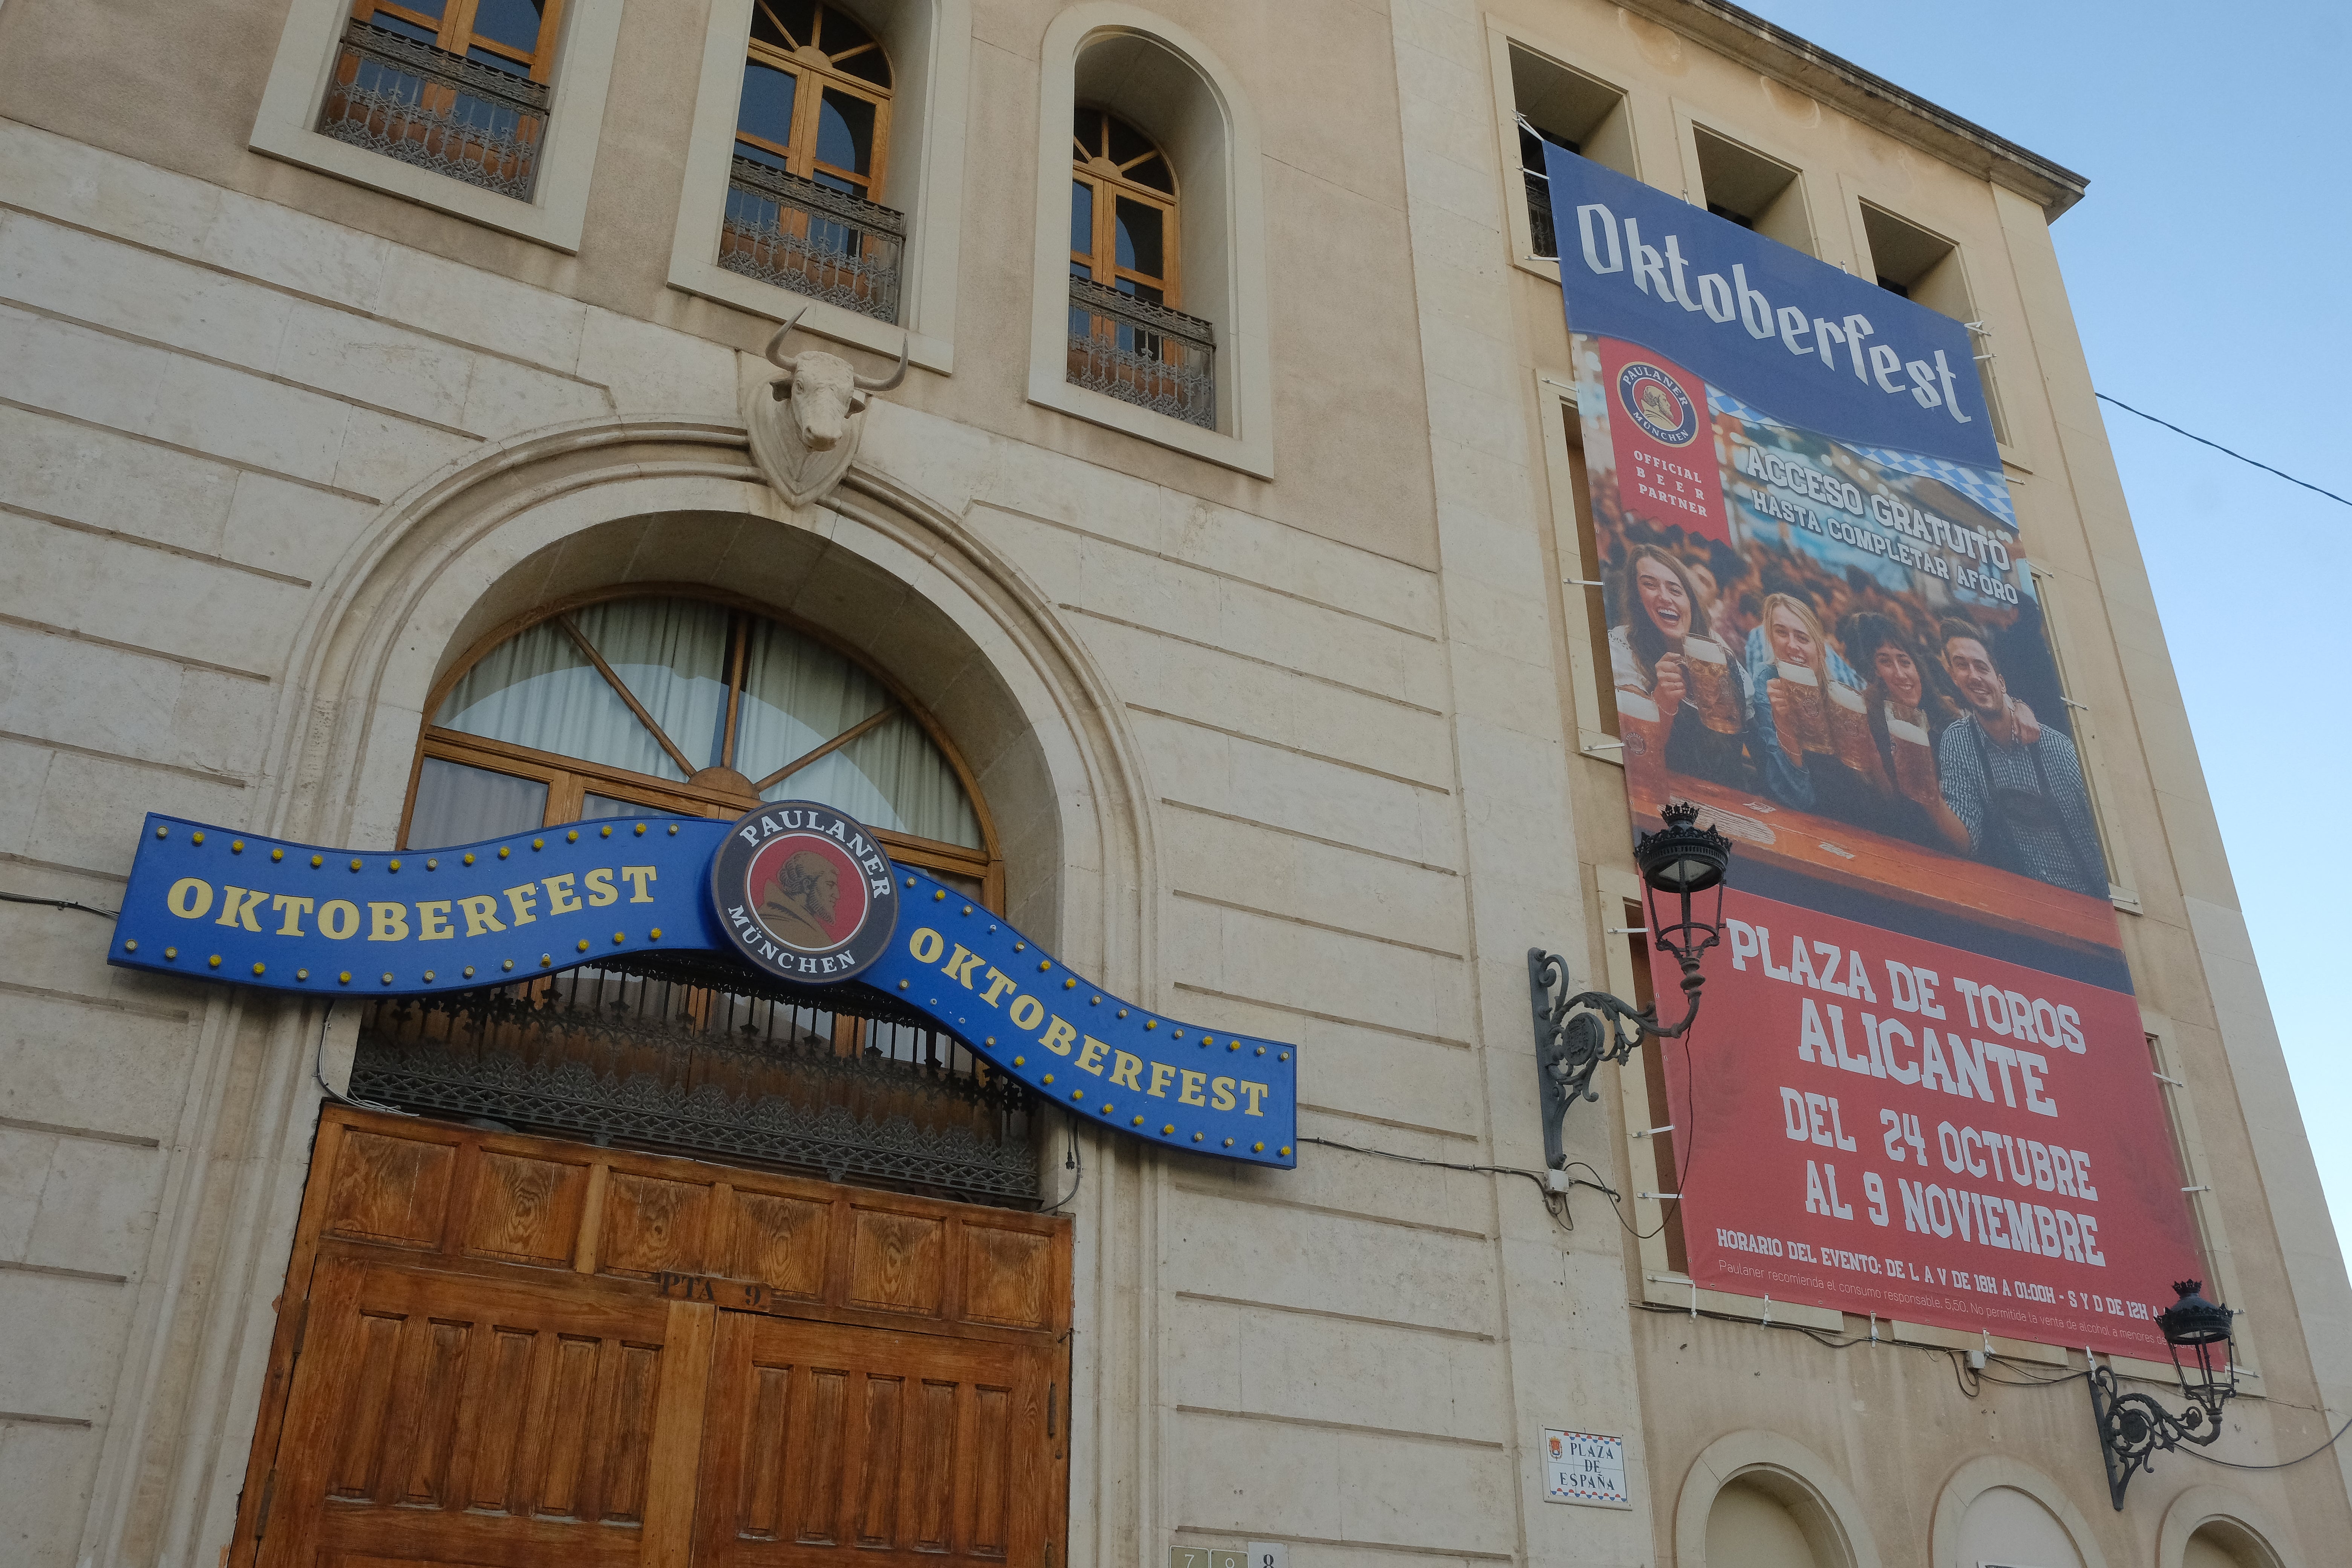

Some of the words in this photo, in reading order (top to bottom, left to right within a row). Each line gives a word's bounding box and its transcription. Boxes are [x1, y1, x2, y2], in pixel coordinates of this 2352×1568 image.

[1577, 204, 1971, 424] Oktoberfest
[1623, 367, 1688, 406] PAULANER
[1633, 412, 1689, 441] MÜNCHEN
[1634, 450, 1701, 483] OFFICIAL
[1638, 483, 1707, 517] PARTNER
[1747, 447, 1864, 515] ACCESO
[1871, 494, 2010, 570] GRATUITO
[1752, 489, 1821, 533] HASTA
[1828, 518, 1949, 579] COMPLETAR
[1957, 566, 2018, 604] AFORO
[739, 810, 890, 899] PAULANER
[167, 865, 657, 941] OKTOBERFEST
[728, 905, 855, 974] MÜNCHEN
[909, 927, 1269, 1116] OKTOBERFEST
[1727, 918, 1876, 1003] PLAZA
[1885, 959, 1946, 1021] DE
[1954, 978, 2086, 1055] TOROS
[1798, 998, 2058, 1117] ALICANTE
[1779, 1086, 1856, 1152] DEL
[1880, 1109, 1928, 1167] 24
[1938, 1120, 2098, 1201] OCTUBRE
[1805, 1159, 1853, 1221] AL
[1863, 1171, 1888, 1227] 9
[1899, 1178, 2105, 1267] NOVIEMBRE
[662, 1272, 715, 1300] PTA
[745, 1286, 760, 1306] 9
[1717, 1228, 1782, 1257] HORARIO
[1787, 1241, 1817, 1263] DEL
[1821, 1247, 1882, 1274] EVENTO:
[1885, 1259, 1905, 1279] DE
[1908, 1263, 1919, 1281] L
[1925, 1266, 1934, 1283] A
[1937, 1268, 1946, 1286] V
[1951, 1270, 1971, 1290] DE
[1974, 1274, 1997, 1294] 18H
[2002, 1279, 2011, 1296] A
[2015, 1281, 2056, 1304] 01:00H
[2067, 1290, 2077, 1308] S
[2080, 1293, 2089, 1310] Y
[2092, 1295, 2103, 1312] D
[2105, 1298, 2124, 1316] DE
[2126, 1301, 2149, 1320] 12H
[1719, 1260, 1764, 1278] Paulaner
[1768, 1270, 1824, 1289] recomienda
[1827, 1280, 1836, 1291] el
[1839, 1283, 1881, 1298] consumo
[1884, 1291, 1943, 1309] responsable.
[1971, 1303, 1984, 1315] No
[1986, 1308, 2026, 1321] permitida
[2029, 1312, 2037, 1323] la
[2040, 1317, 2064, 1328] venta
[2066, 1319, 2077, 1330] de
[2079, 1322, 2111, 1336] alcohol
[2113, 1329, 2118, 1337] a
[2120, 1330, 2154, 1343] menores
[1560, 1472, 1615, 1490] ESPAÑA
[1571, 1442, 1614, 1459] PLAZA
[1585, 1459, 1601, 1473] DE
